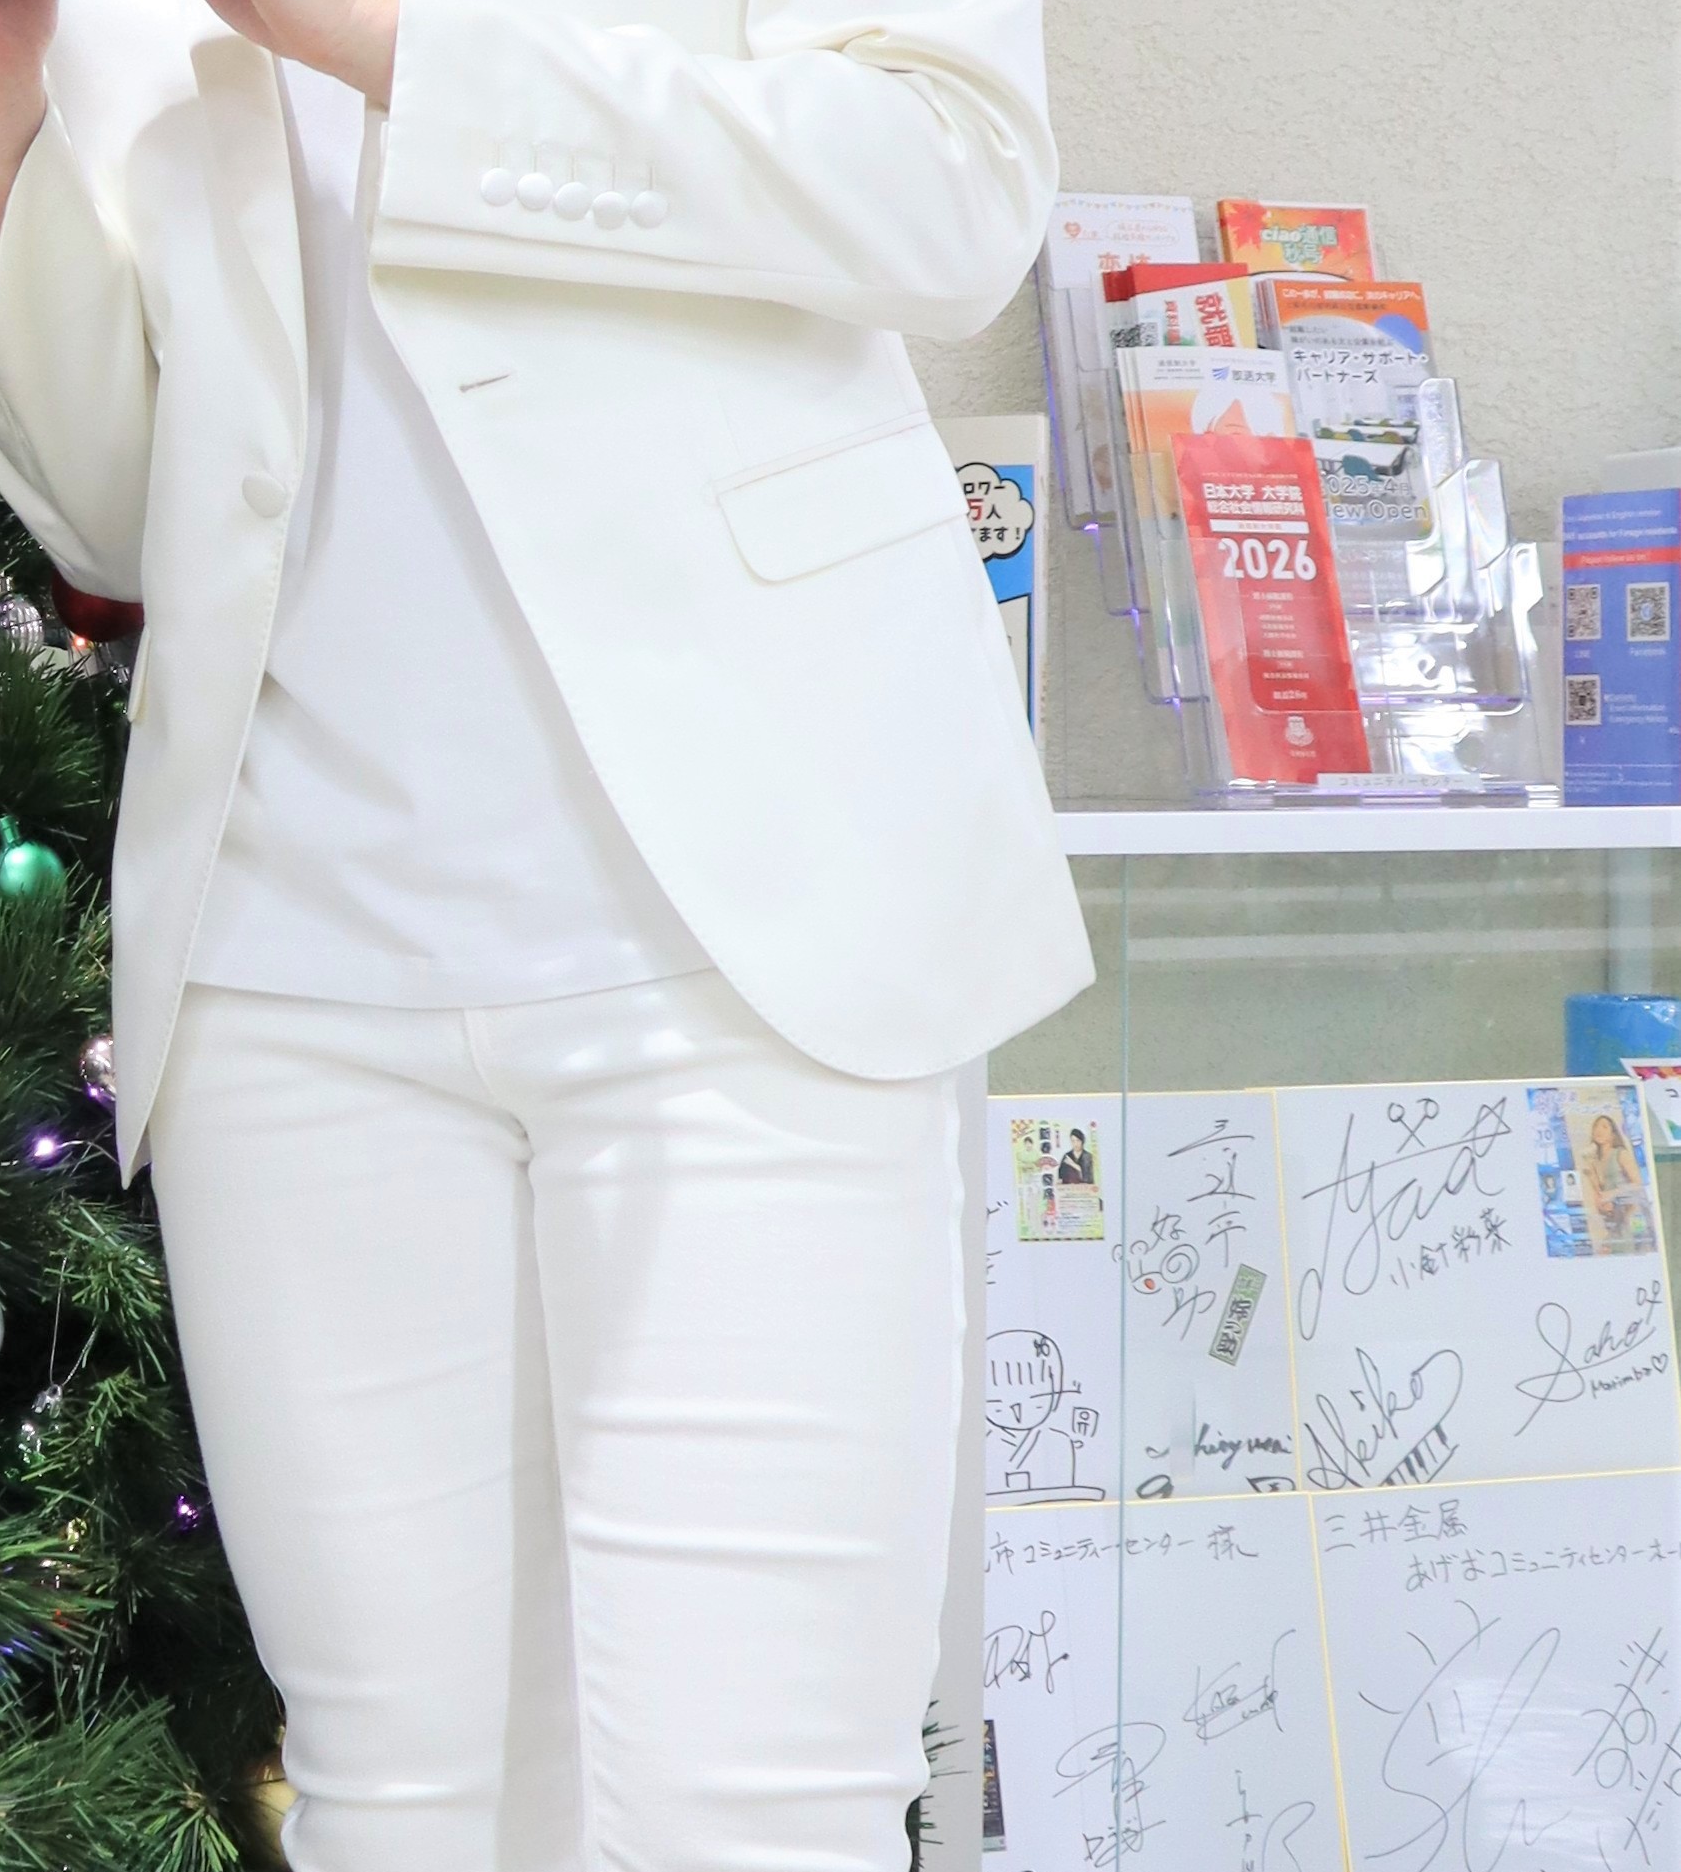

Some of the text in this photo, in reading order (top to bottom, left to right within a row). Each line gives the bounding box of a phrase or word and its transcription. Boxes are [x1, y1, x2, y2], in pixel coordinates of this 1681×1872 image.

[1293, 350, 1429, 366] キャリア・サポート・
[1231, 370, 1277, 384] 放送大学
[1296, 369, 1379, 384] パートナーズ
[1202, 482, 1304, 502] 日本大学 大学院
[1324, 476, 1411, 496] 025年4月
[1325, 501, 1428, 520] ew Open
[971, 526, 1021, 543] ます!
[1217, 537, 1317, 581] 2026
[1339, 777, 1464, 787] コミュニティーセンター
[1324, 1499, 1469, 1553] 三井金属
[984, 1531, 1195, 1575] 市コミュニティーセンター
